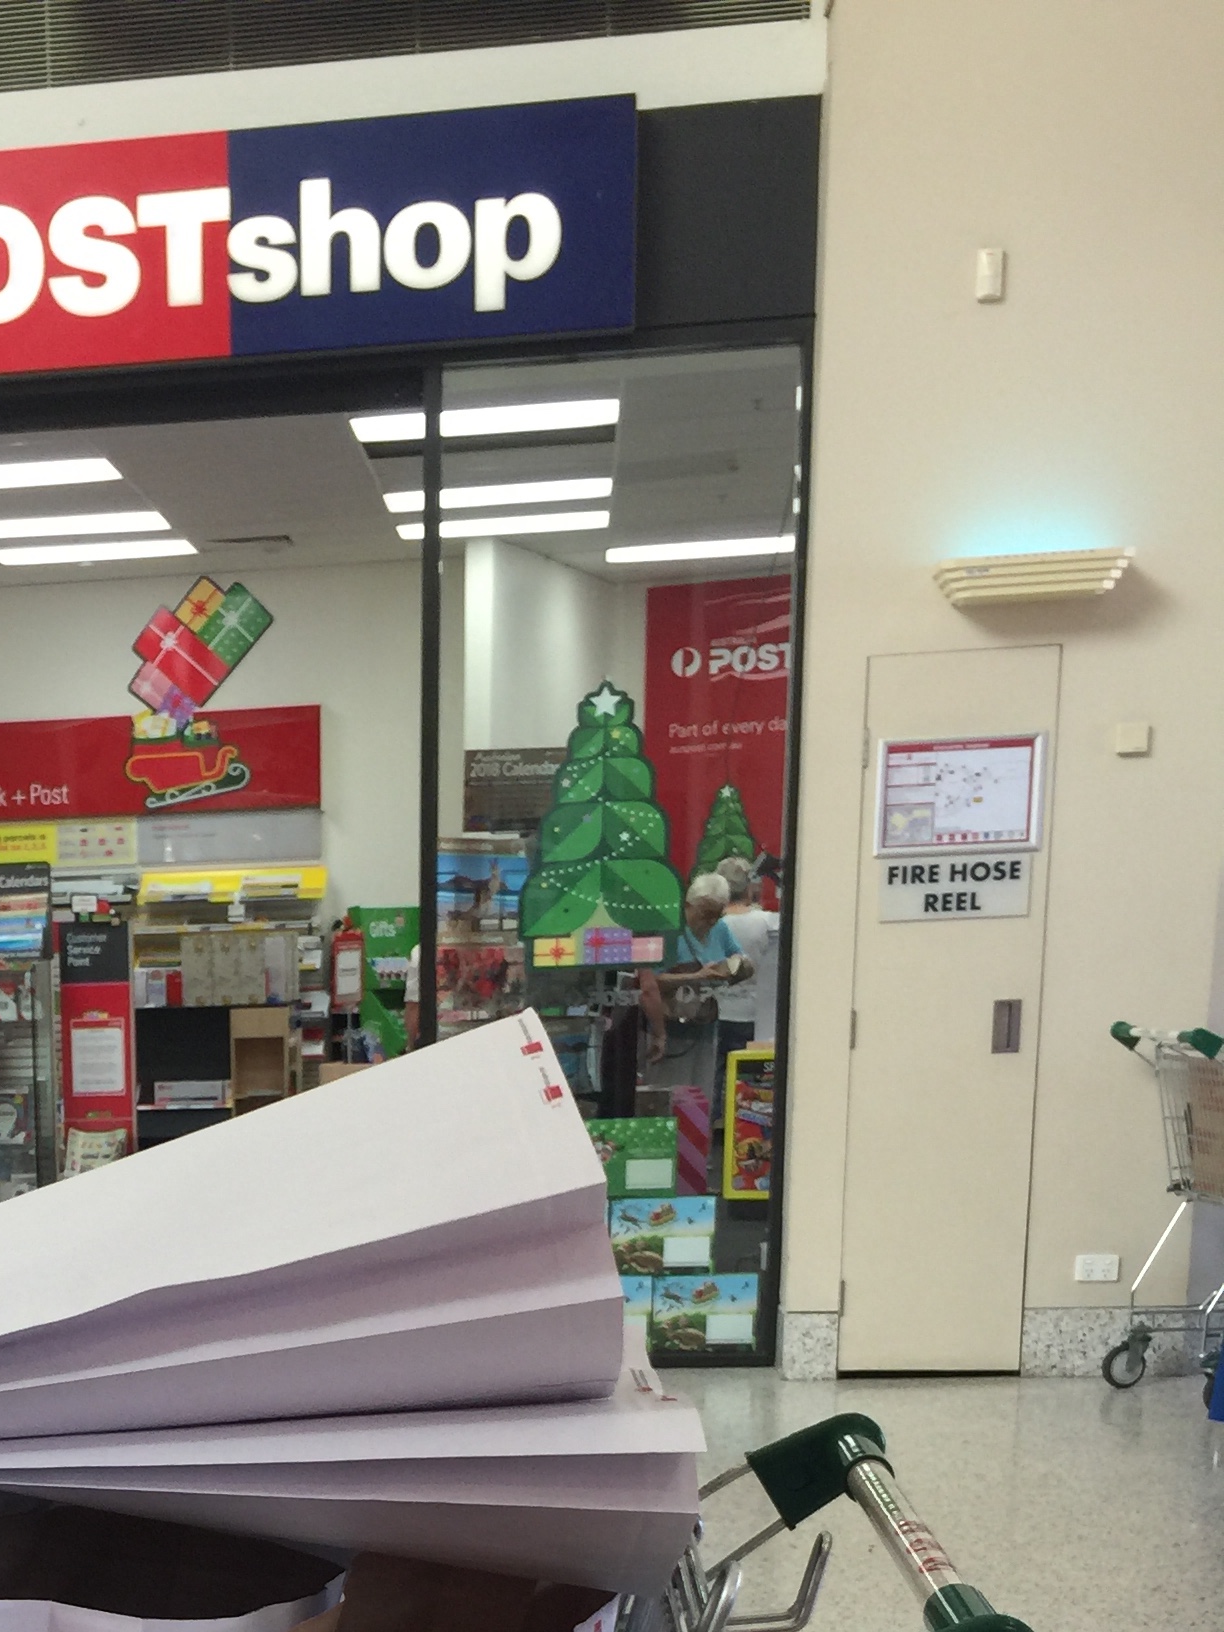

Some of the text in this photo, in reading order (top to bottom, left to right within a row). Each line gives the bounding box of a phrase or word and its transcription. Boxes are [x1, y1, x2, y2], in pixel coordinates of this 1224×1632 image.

[669, 723, 698, 738] Part
[702, 720, 719, 737] of
[721, 720, 765, 735] every
[30, 784, 69, 806] Post
[887, 861, 1022, 885] FIRE HOSE
[924, 892, 981, 912] REEL
